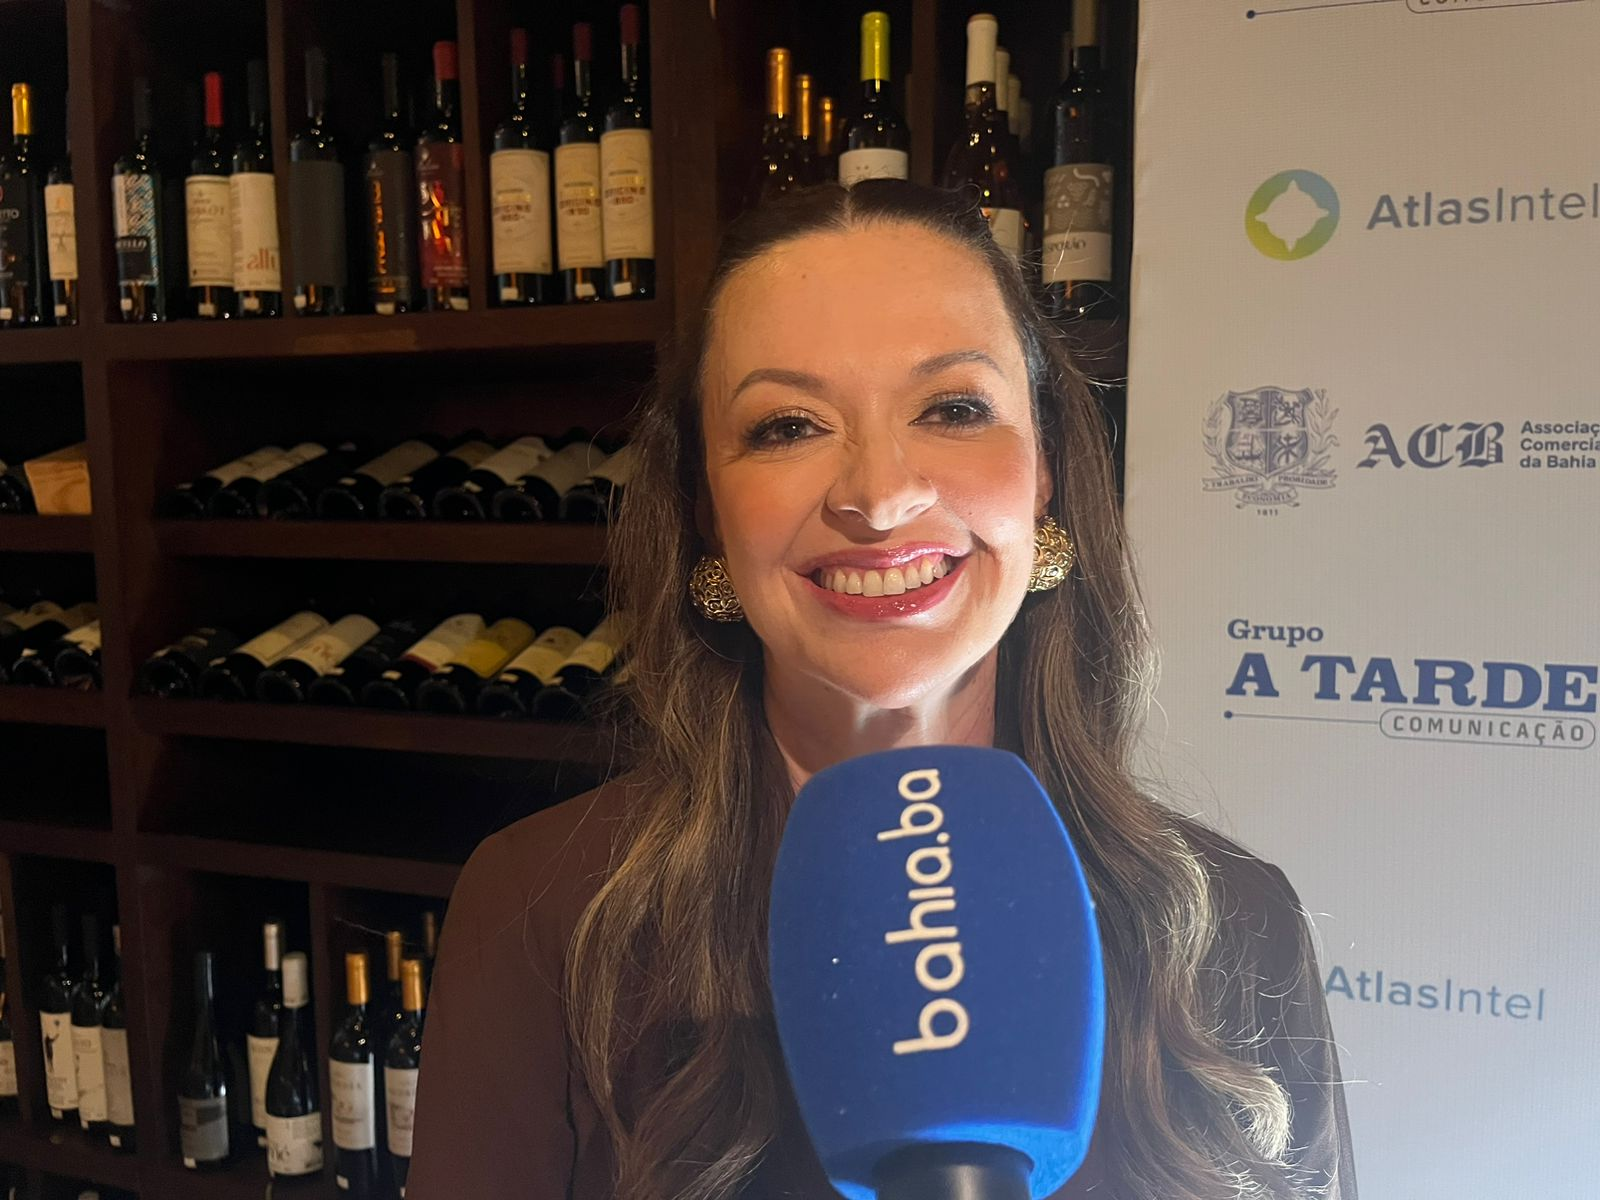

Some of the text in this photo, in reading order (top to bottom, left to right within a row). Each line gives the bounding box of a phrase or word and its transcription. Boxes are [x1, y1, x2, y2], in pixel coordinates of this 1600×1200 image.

[1367, 183, 1599, 231] AtlasIntel
[1356, 421, 1505, 471] ACB
[1520, 420, 1600, 437] Associaç
[1520, 455, 1597, 468] da Bahia
[1227, 619, 1325, 648] Grupo
[1225, 652, 1599, 713] A TARDE
[1392, 714, 1585, 746] COMUNICAÇÃO
[877, 768, 970, 1055] bahia.ba
[1324, 965, 1546, 1021] AtlasIntel
